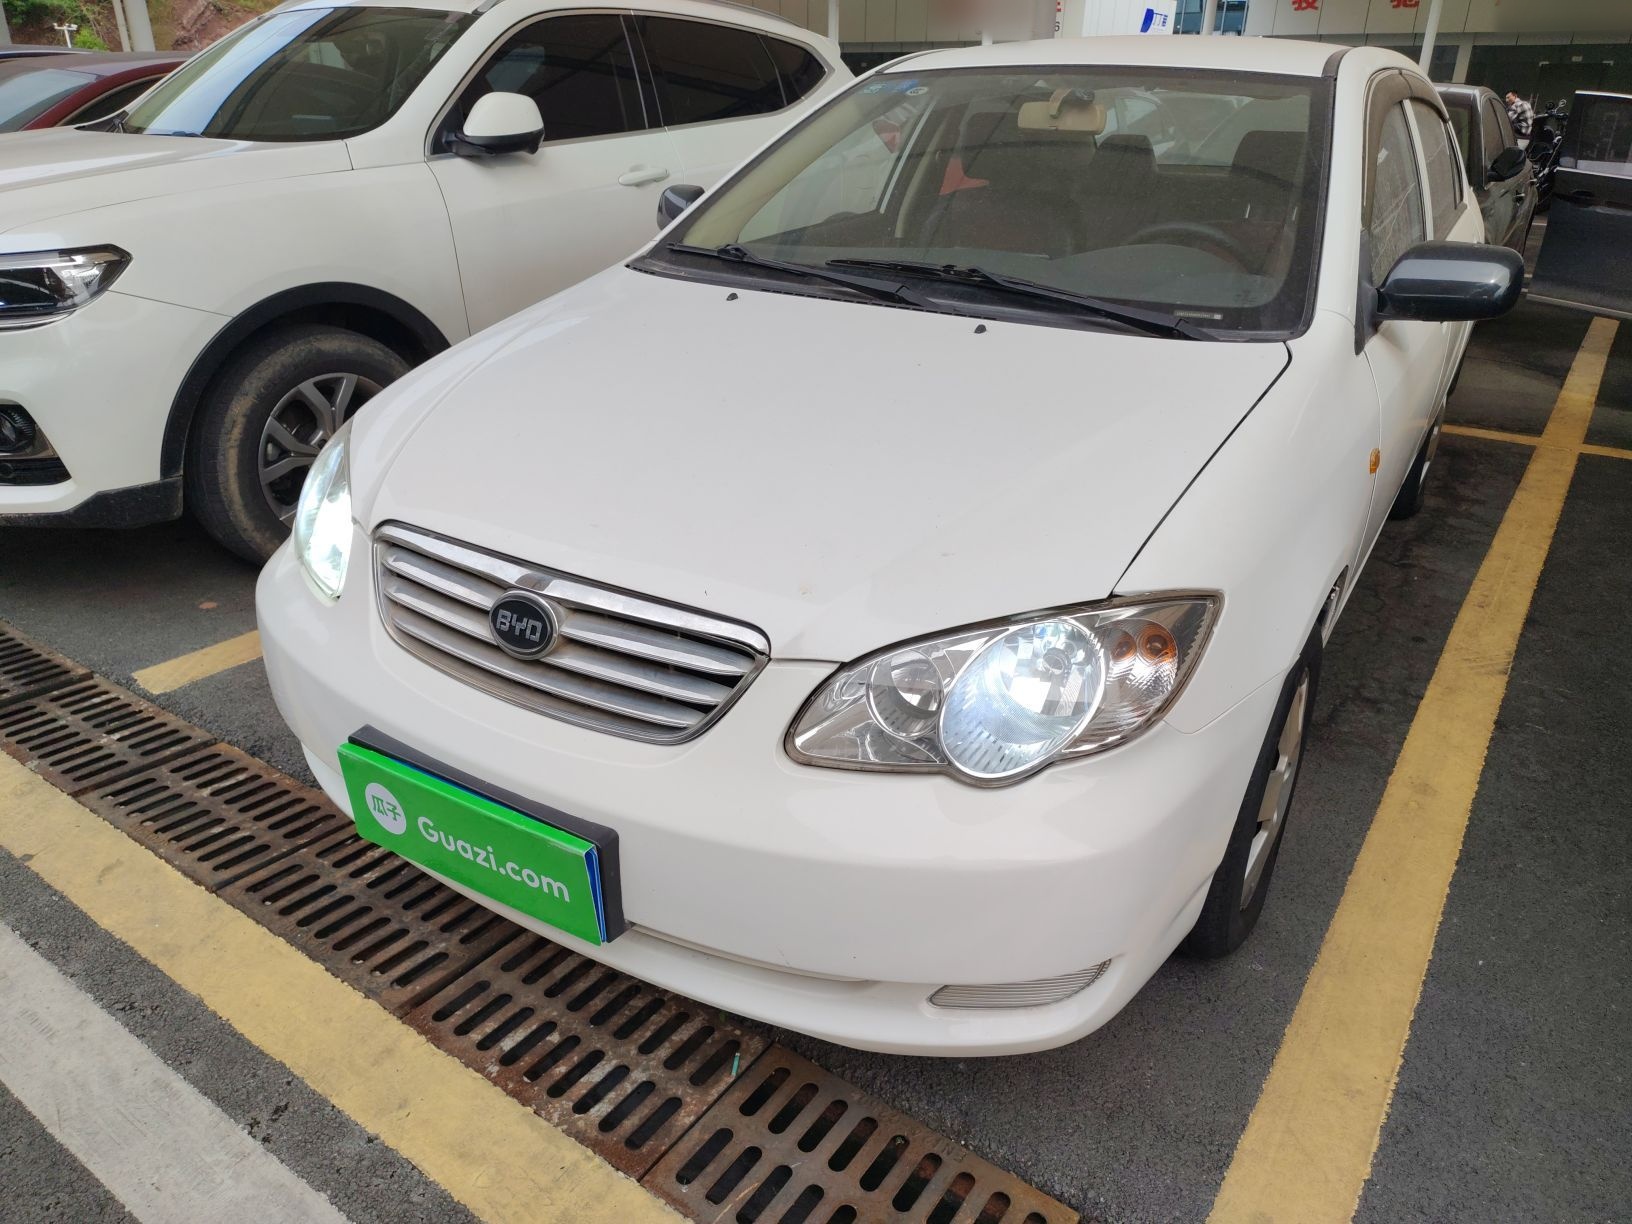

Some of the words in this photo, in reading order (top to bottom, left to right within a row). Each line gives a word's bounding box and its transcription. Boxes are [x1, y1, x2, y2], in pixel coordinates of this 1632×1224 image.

[495, 609, 544, 643] BYD
[371, 794, 402, 822] 瓜子
[417, 816, 570, 903] Guazi.com
